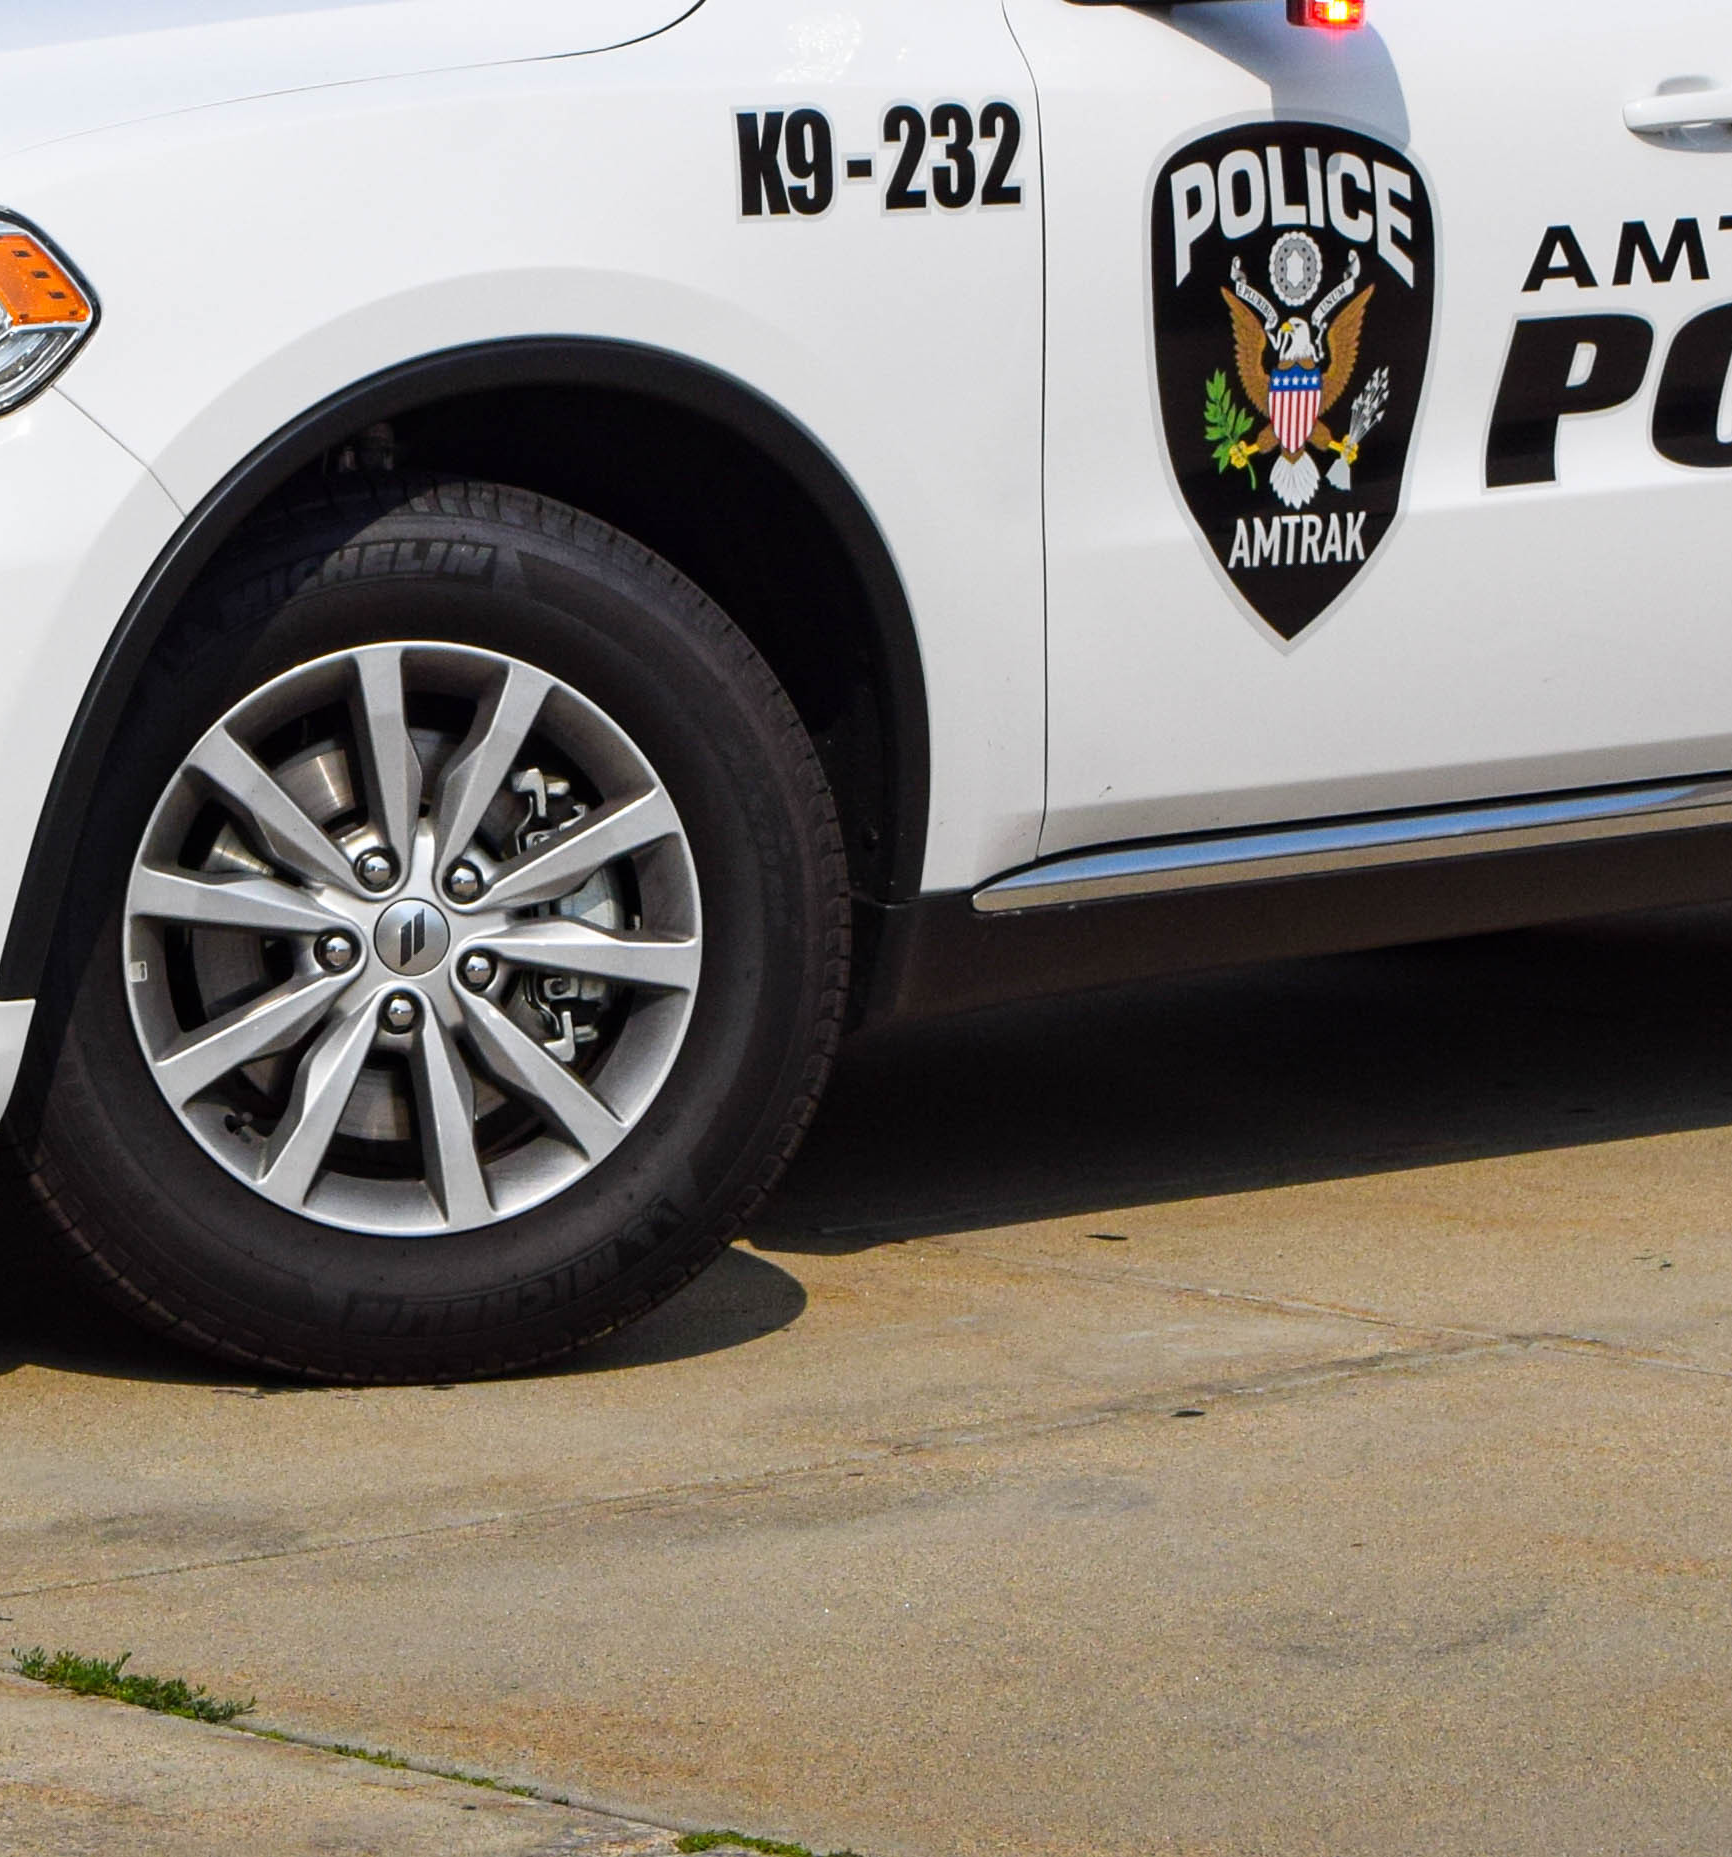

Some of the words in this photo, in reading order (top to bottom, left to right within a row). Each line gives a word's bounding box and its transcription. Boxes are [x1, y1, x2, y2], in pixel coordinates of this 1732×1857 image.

[1169, 145, 1416, 289] POLICE
[1318, 284, 1347, 315] UNUM
[1227, 510, 1367, 569] AMTRAK
